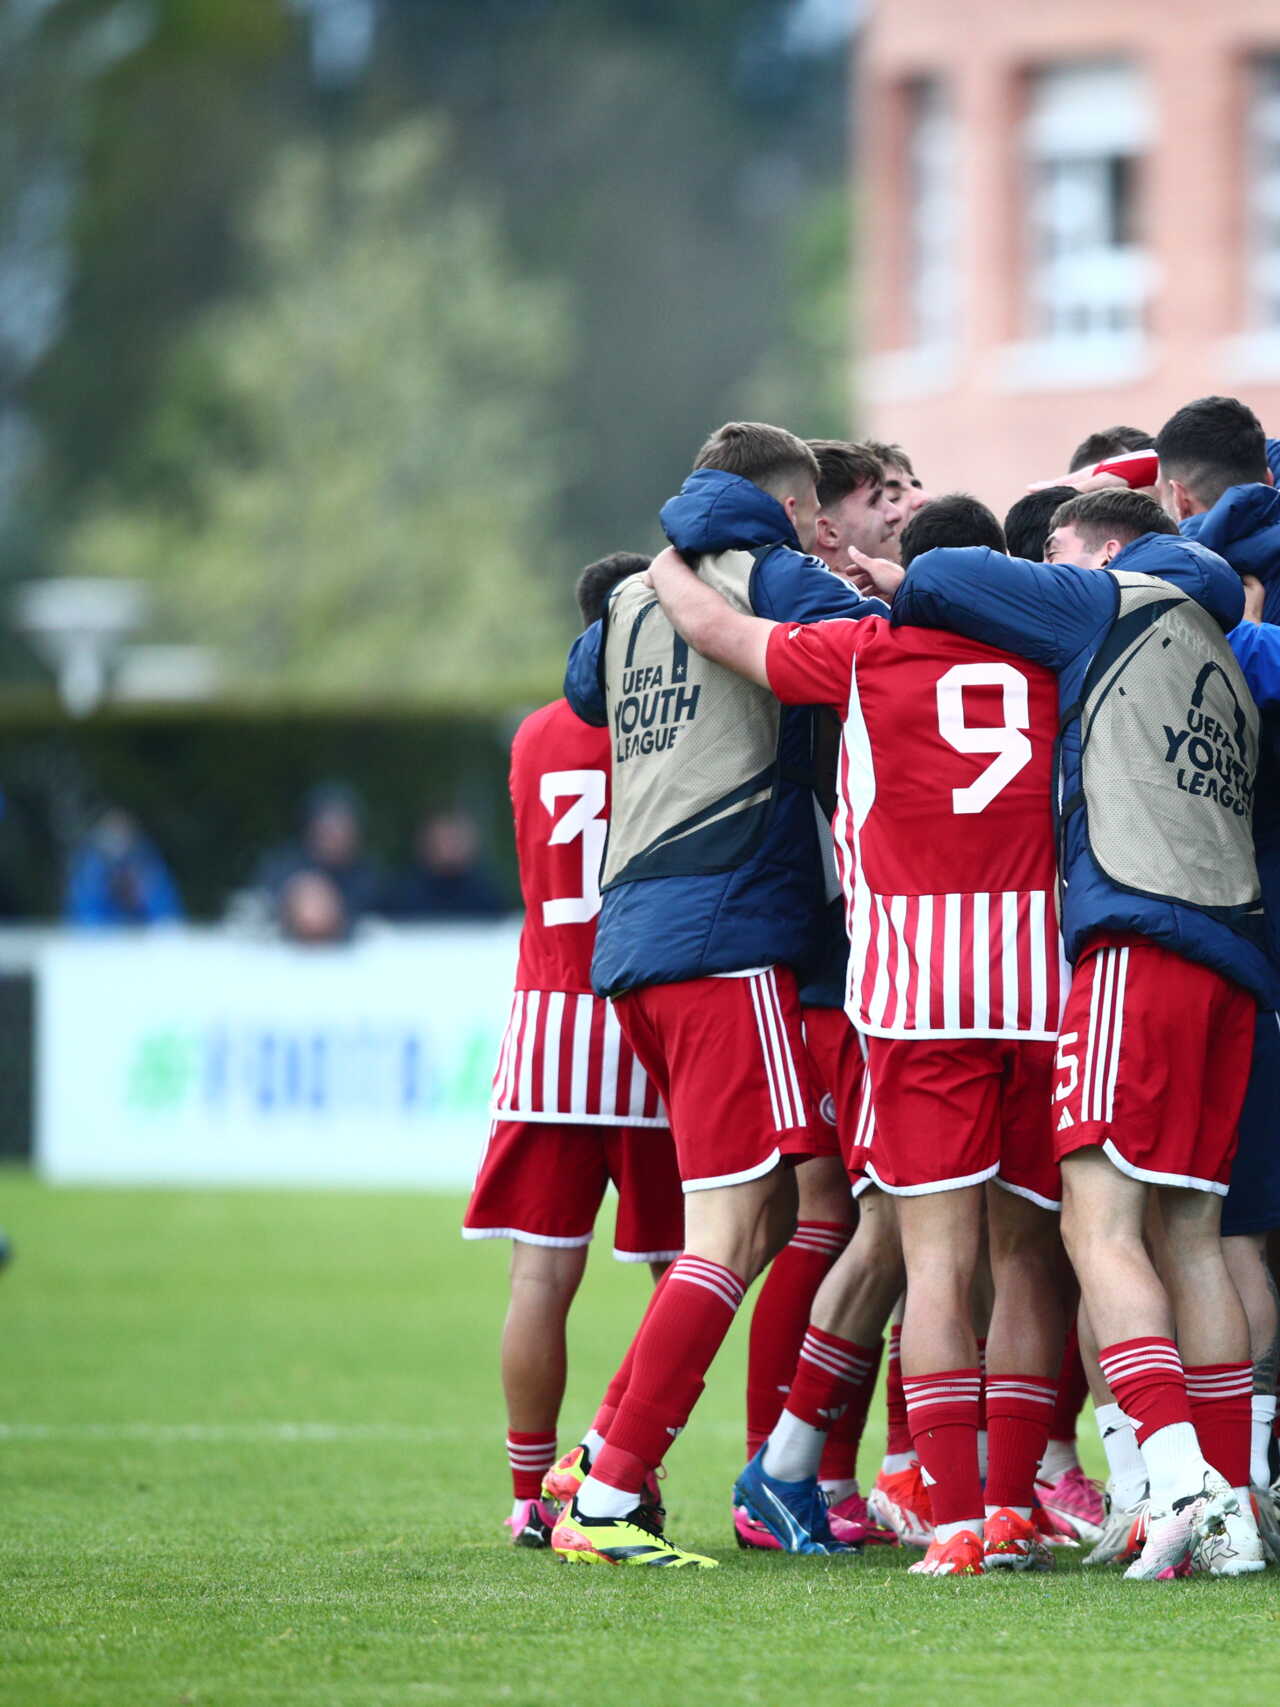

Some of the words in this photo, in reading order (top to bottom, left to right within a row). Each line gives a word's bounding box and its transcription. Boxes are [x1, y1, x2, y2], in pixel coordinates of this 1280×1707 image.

[623, 665, 663, 696] UEFA
[615, 684, 702, 739] YOUTH
[1187, 709, 1235, 754] UEFA
[617, 726, 679, 763] LEAGUE
[936, 662, 1032, 815] 9
[540, 769, 608, 928] 3
